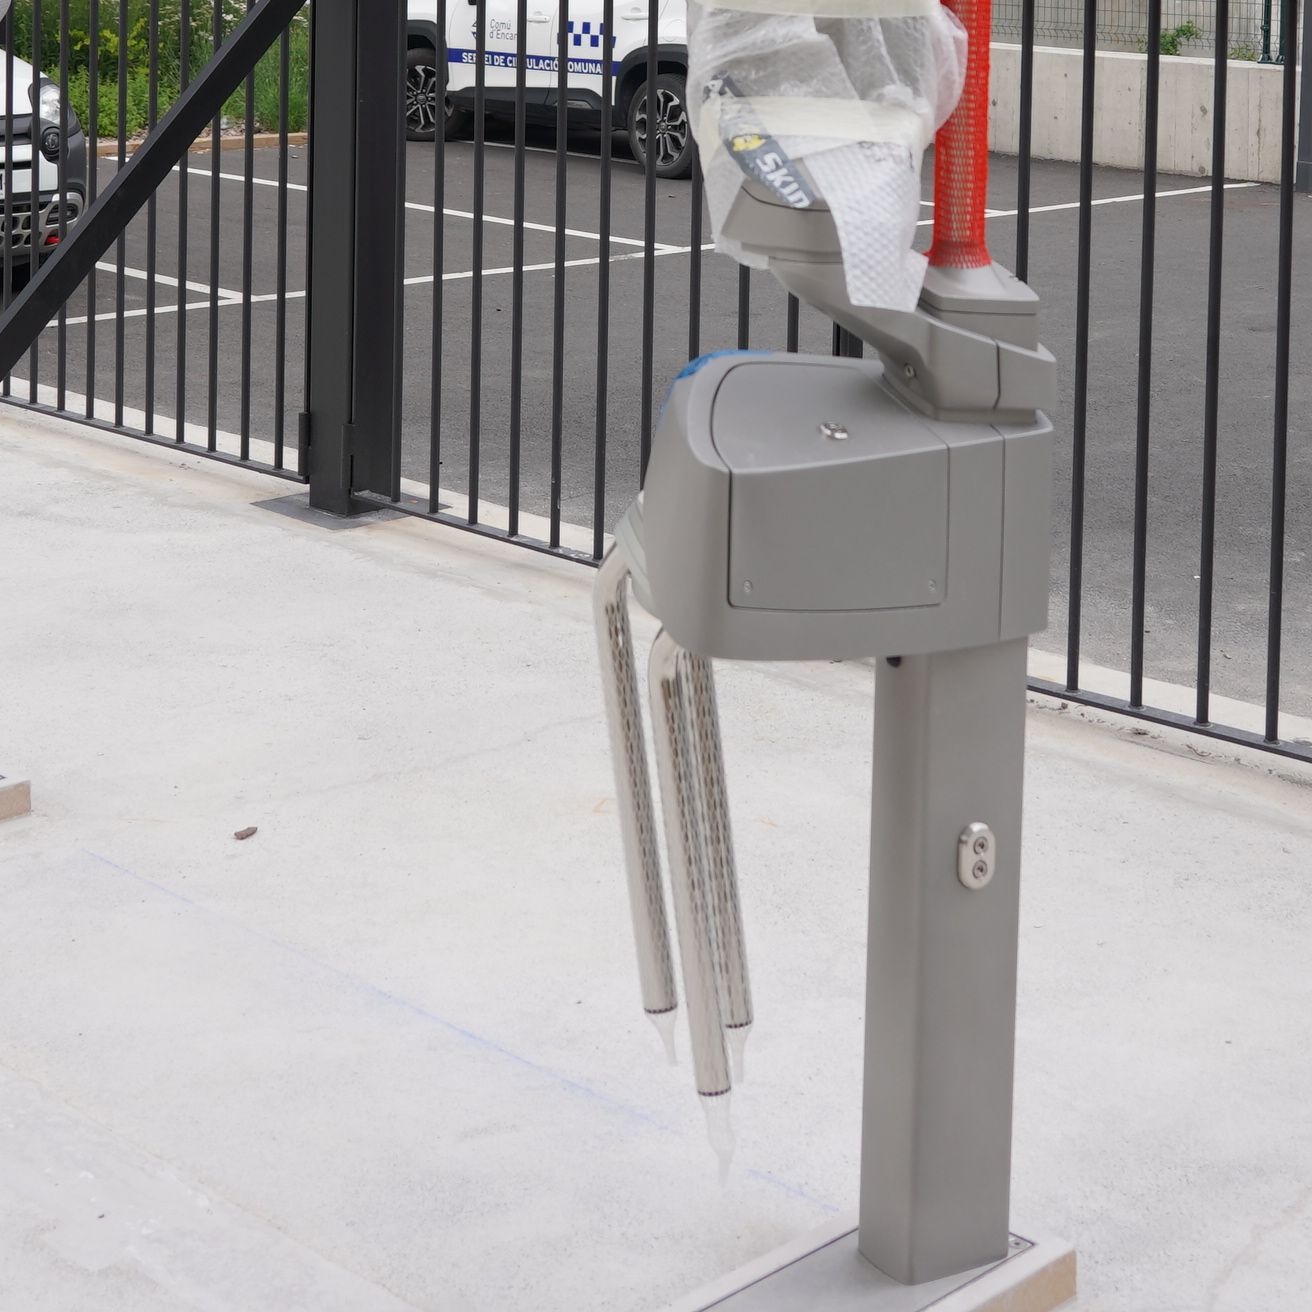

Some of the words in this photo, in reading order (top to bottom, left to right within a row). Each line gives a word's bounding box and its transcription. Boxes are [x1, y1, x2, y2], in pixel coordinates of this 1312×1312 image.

[489, 18, 512, 30] Comú
[488, 29, 518, 41] d'Enca
[462, 52, 492, 65] SEEI
[493, 55, 506, 67] DE
[506, 56, 561, 71] CIULACIÓ
[564, 61, 606, 75] OMUNA
